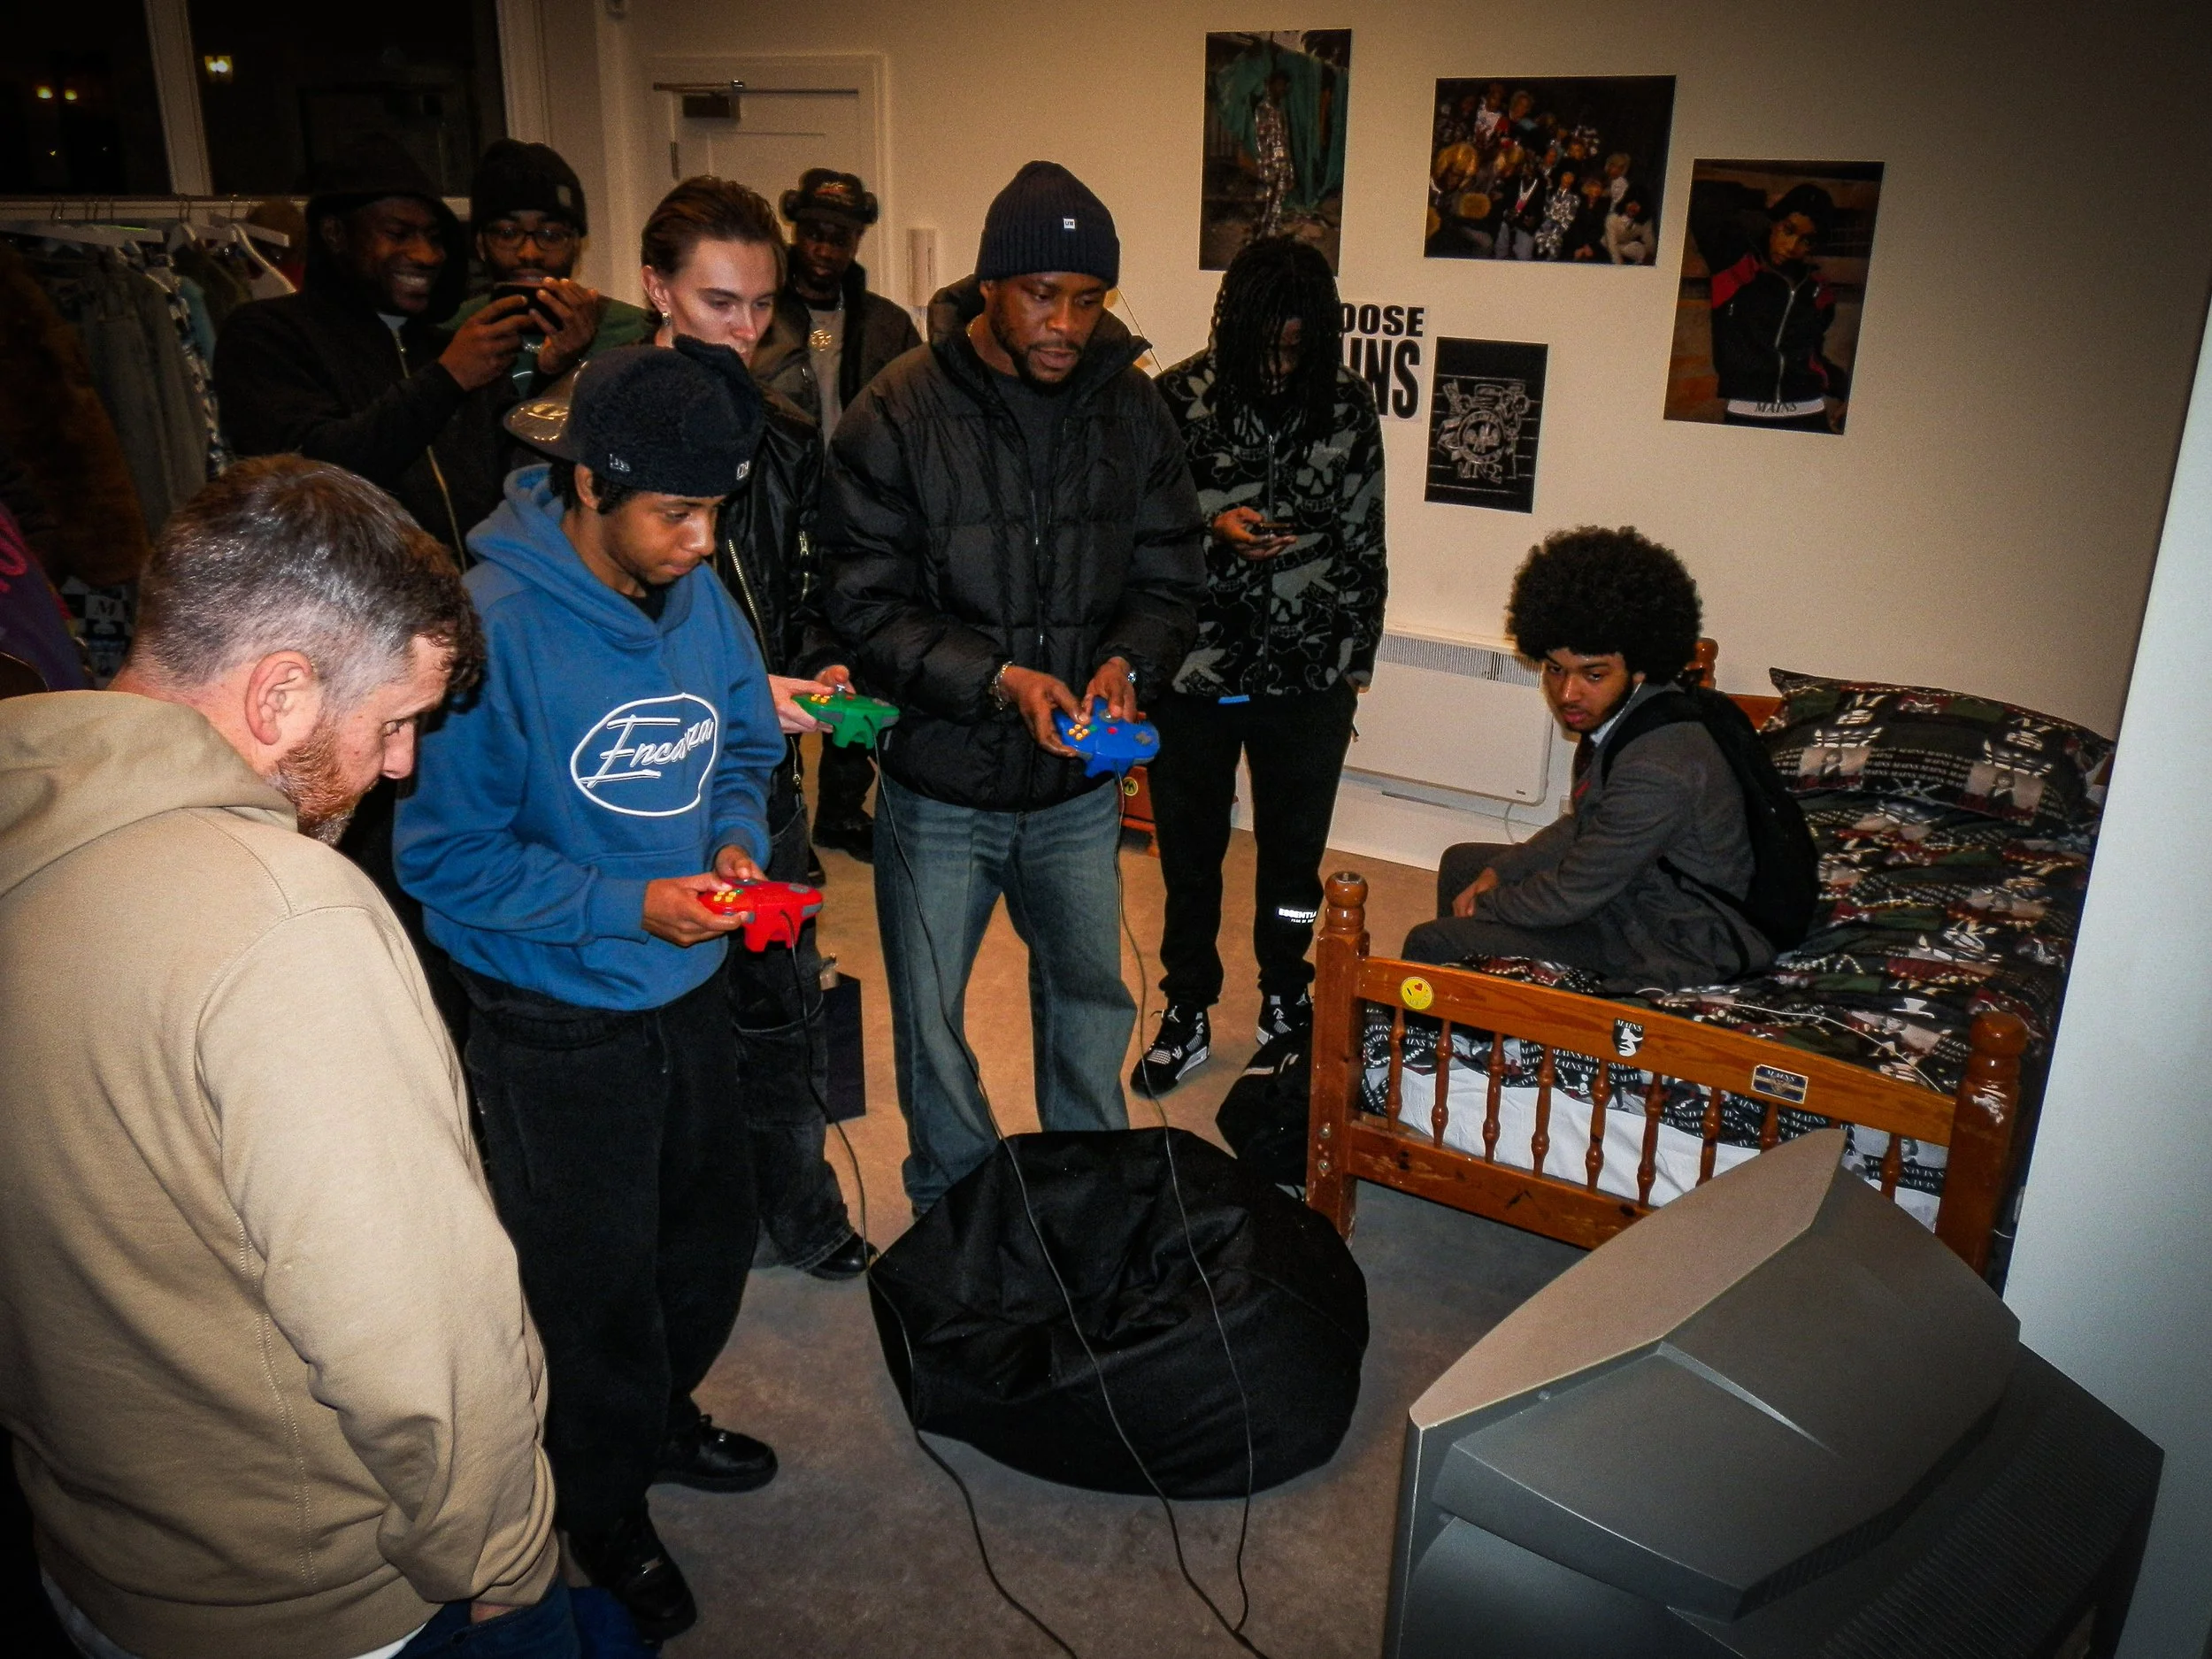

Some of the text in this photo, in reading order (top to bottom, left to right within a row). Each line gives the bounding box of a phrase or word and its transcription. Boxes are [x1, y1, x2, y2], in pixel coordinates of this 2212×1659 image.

[1340, 303, 1425, 337] OOSE
[1755, 403, 1797, 413] MAINS
[1616, 1019, 1643, 1032] MAINS
[1765, 1070, 1795, 1081] MAINS
